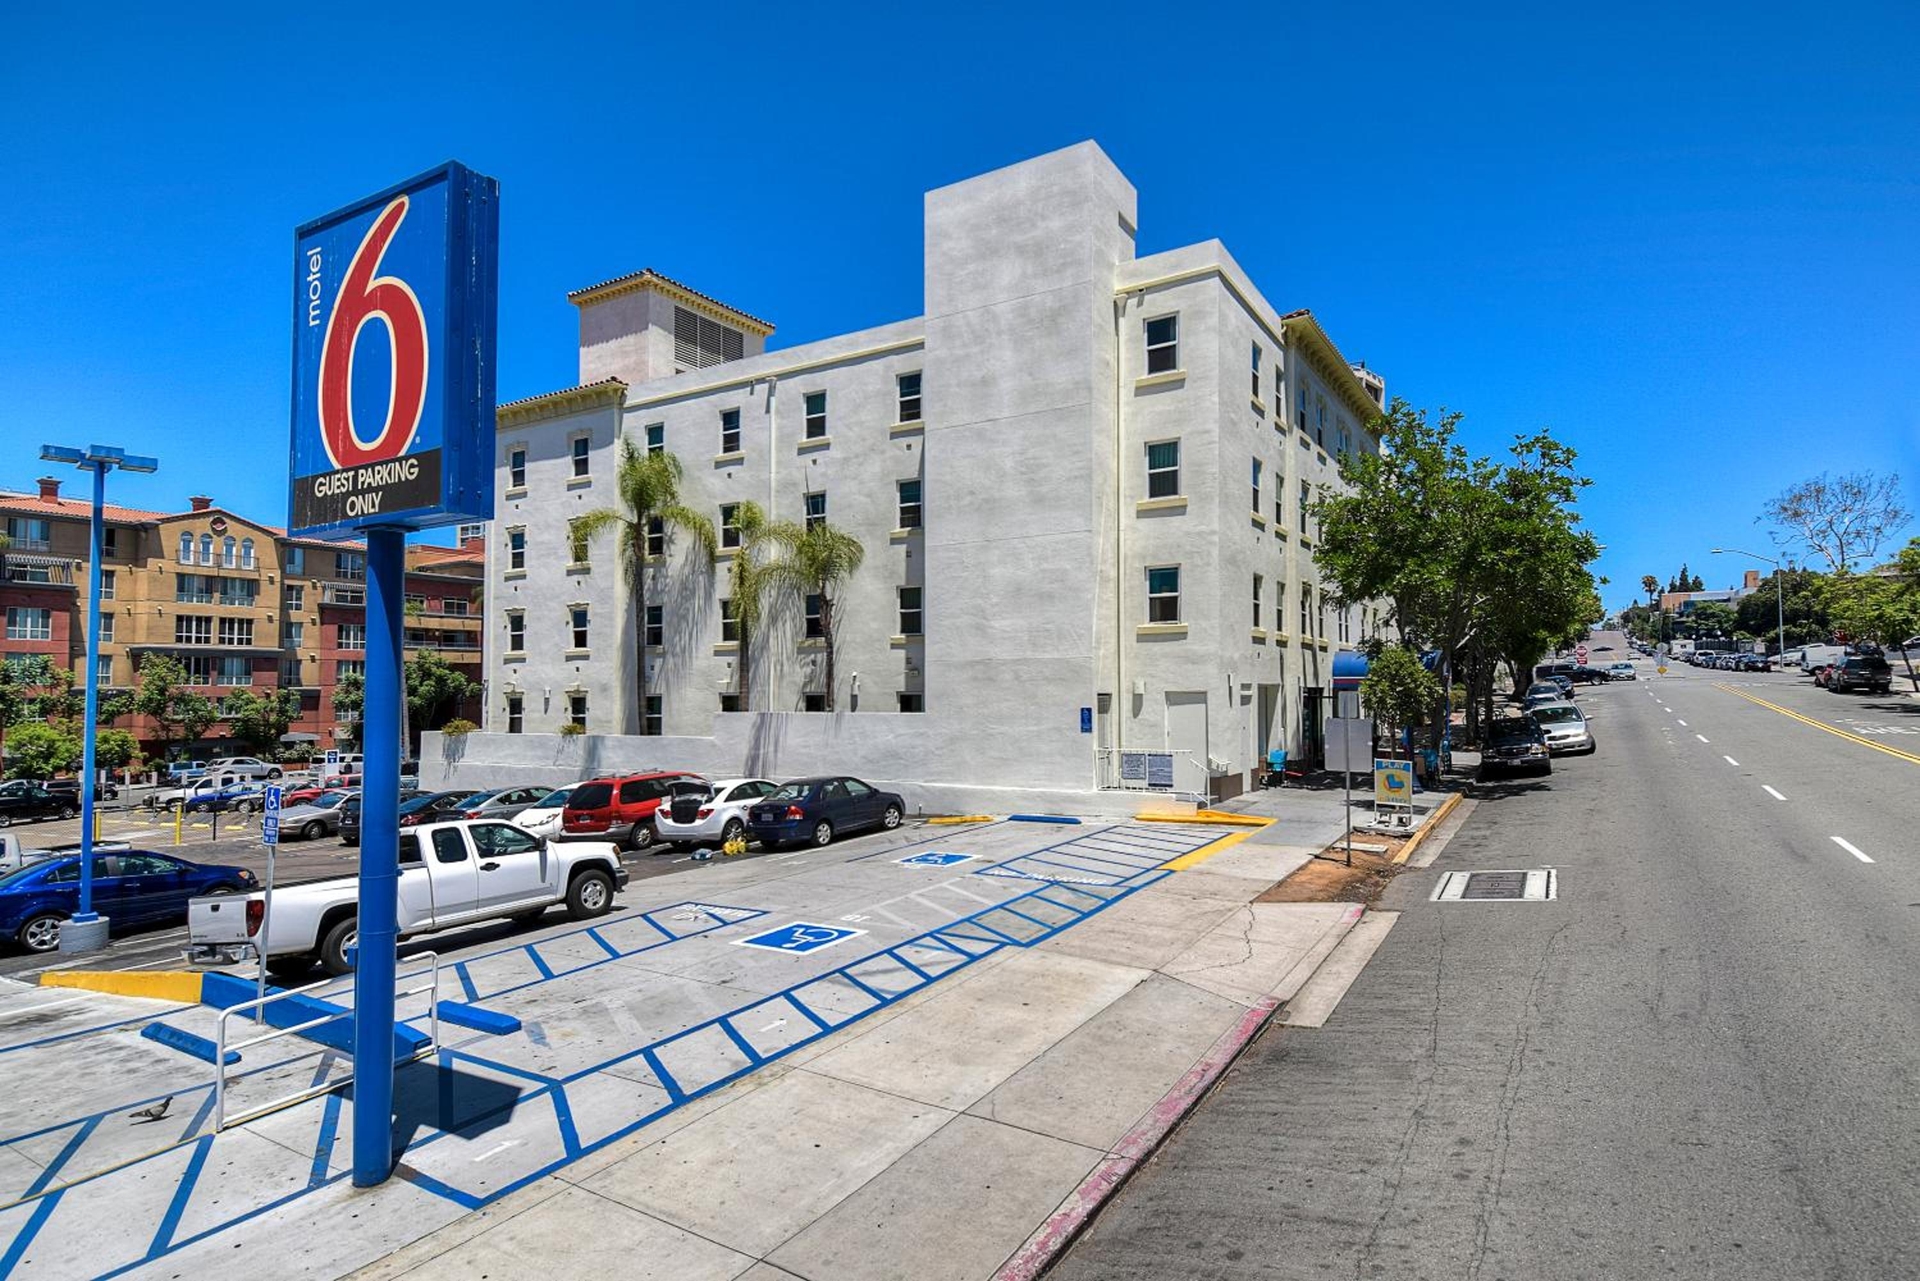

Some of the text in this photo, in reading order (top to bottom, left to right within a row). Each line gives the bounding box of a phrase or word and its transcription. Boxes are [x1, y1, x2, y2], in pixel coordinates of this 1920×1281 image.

[307, 246, 322, 327] motel
[317, 194, 429, 470] 6
[314, 457, 419, 498] GUEST PARKING
[346, 491, 383, 517] ONLY
